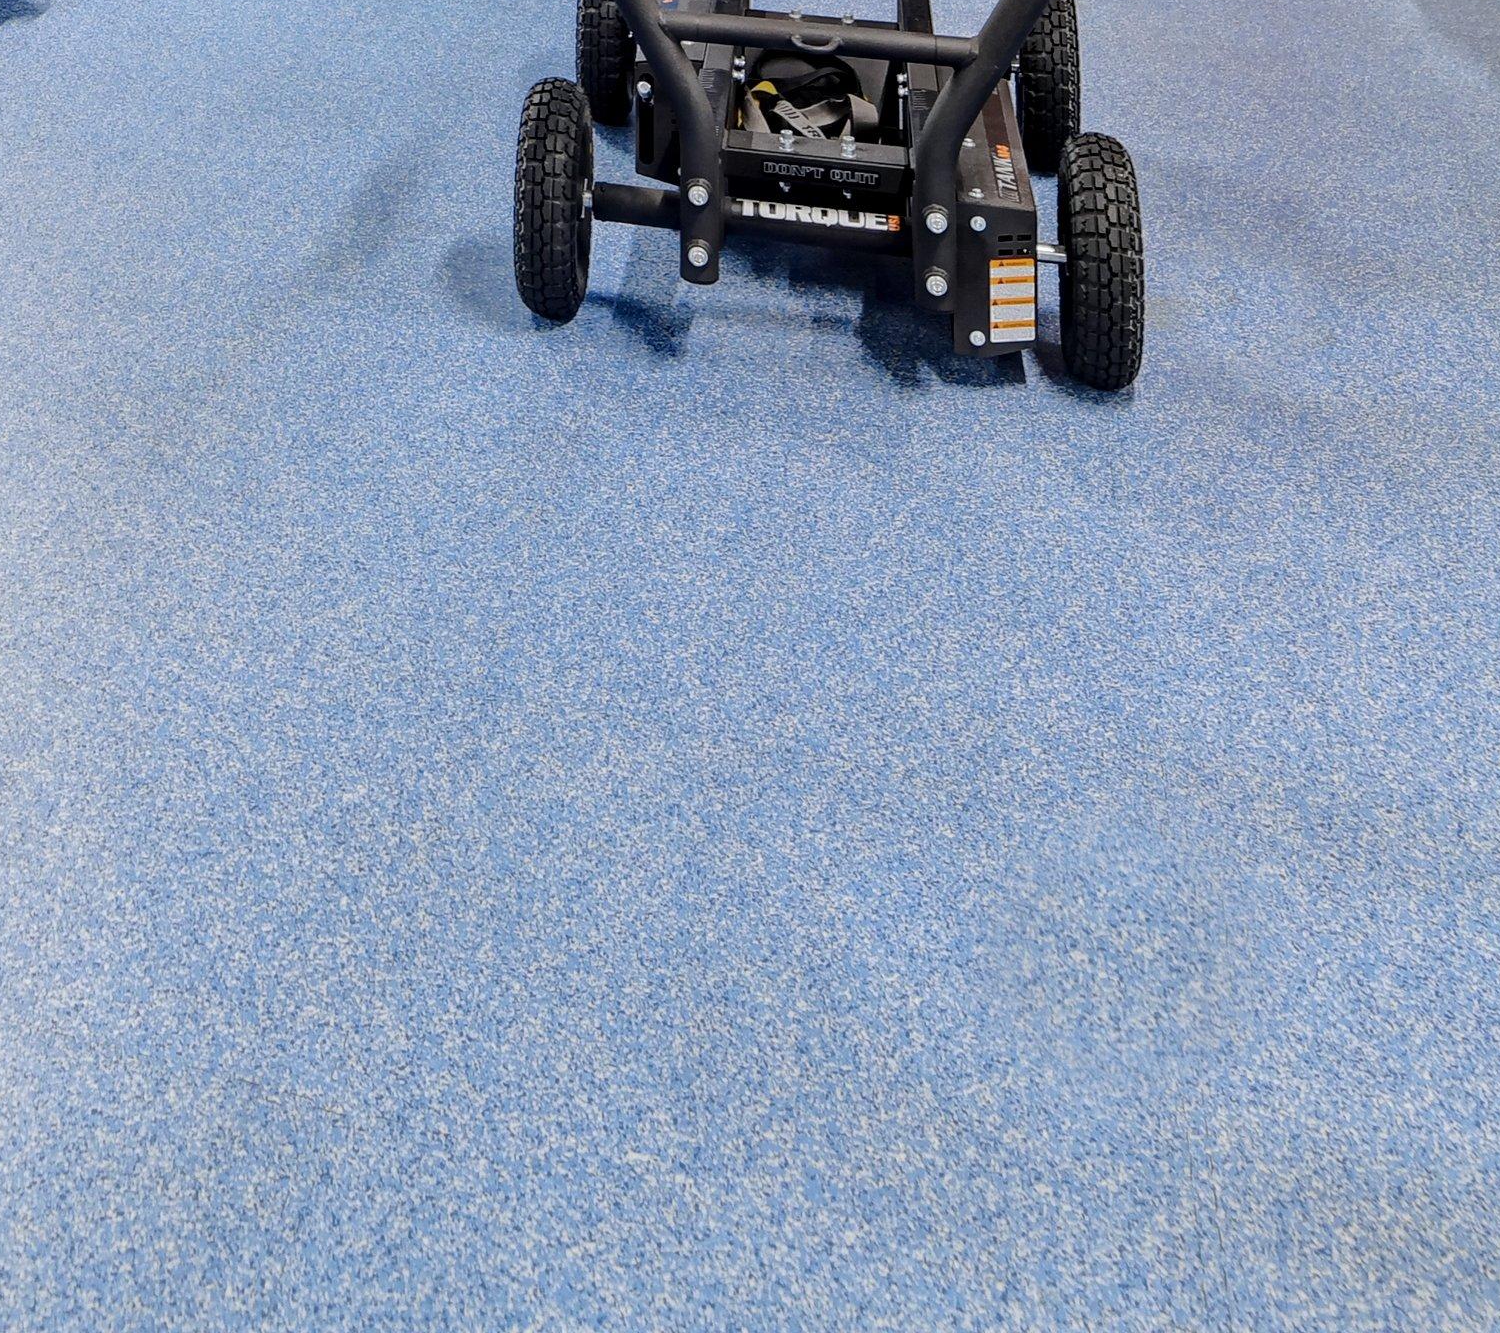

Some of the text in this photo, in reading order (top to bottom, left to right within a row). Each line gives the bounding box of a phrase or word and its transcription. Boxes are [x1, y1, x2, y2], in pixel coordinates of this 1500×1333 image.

[763, 161, 879, 185] DON'T QUIT
[736, 197, 888, 232] TORQUE
